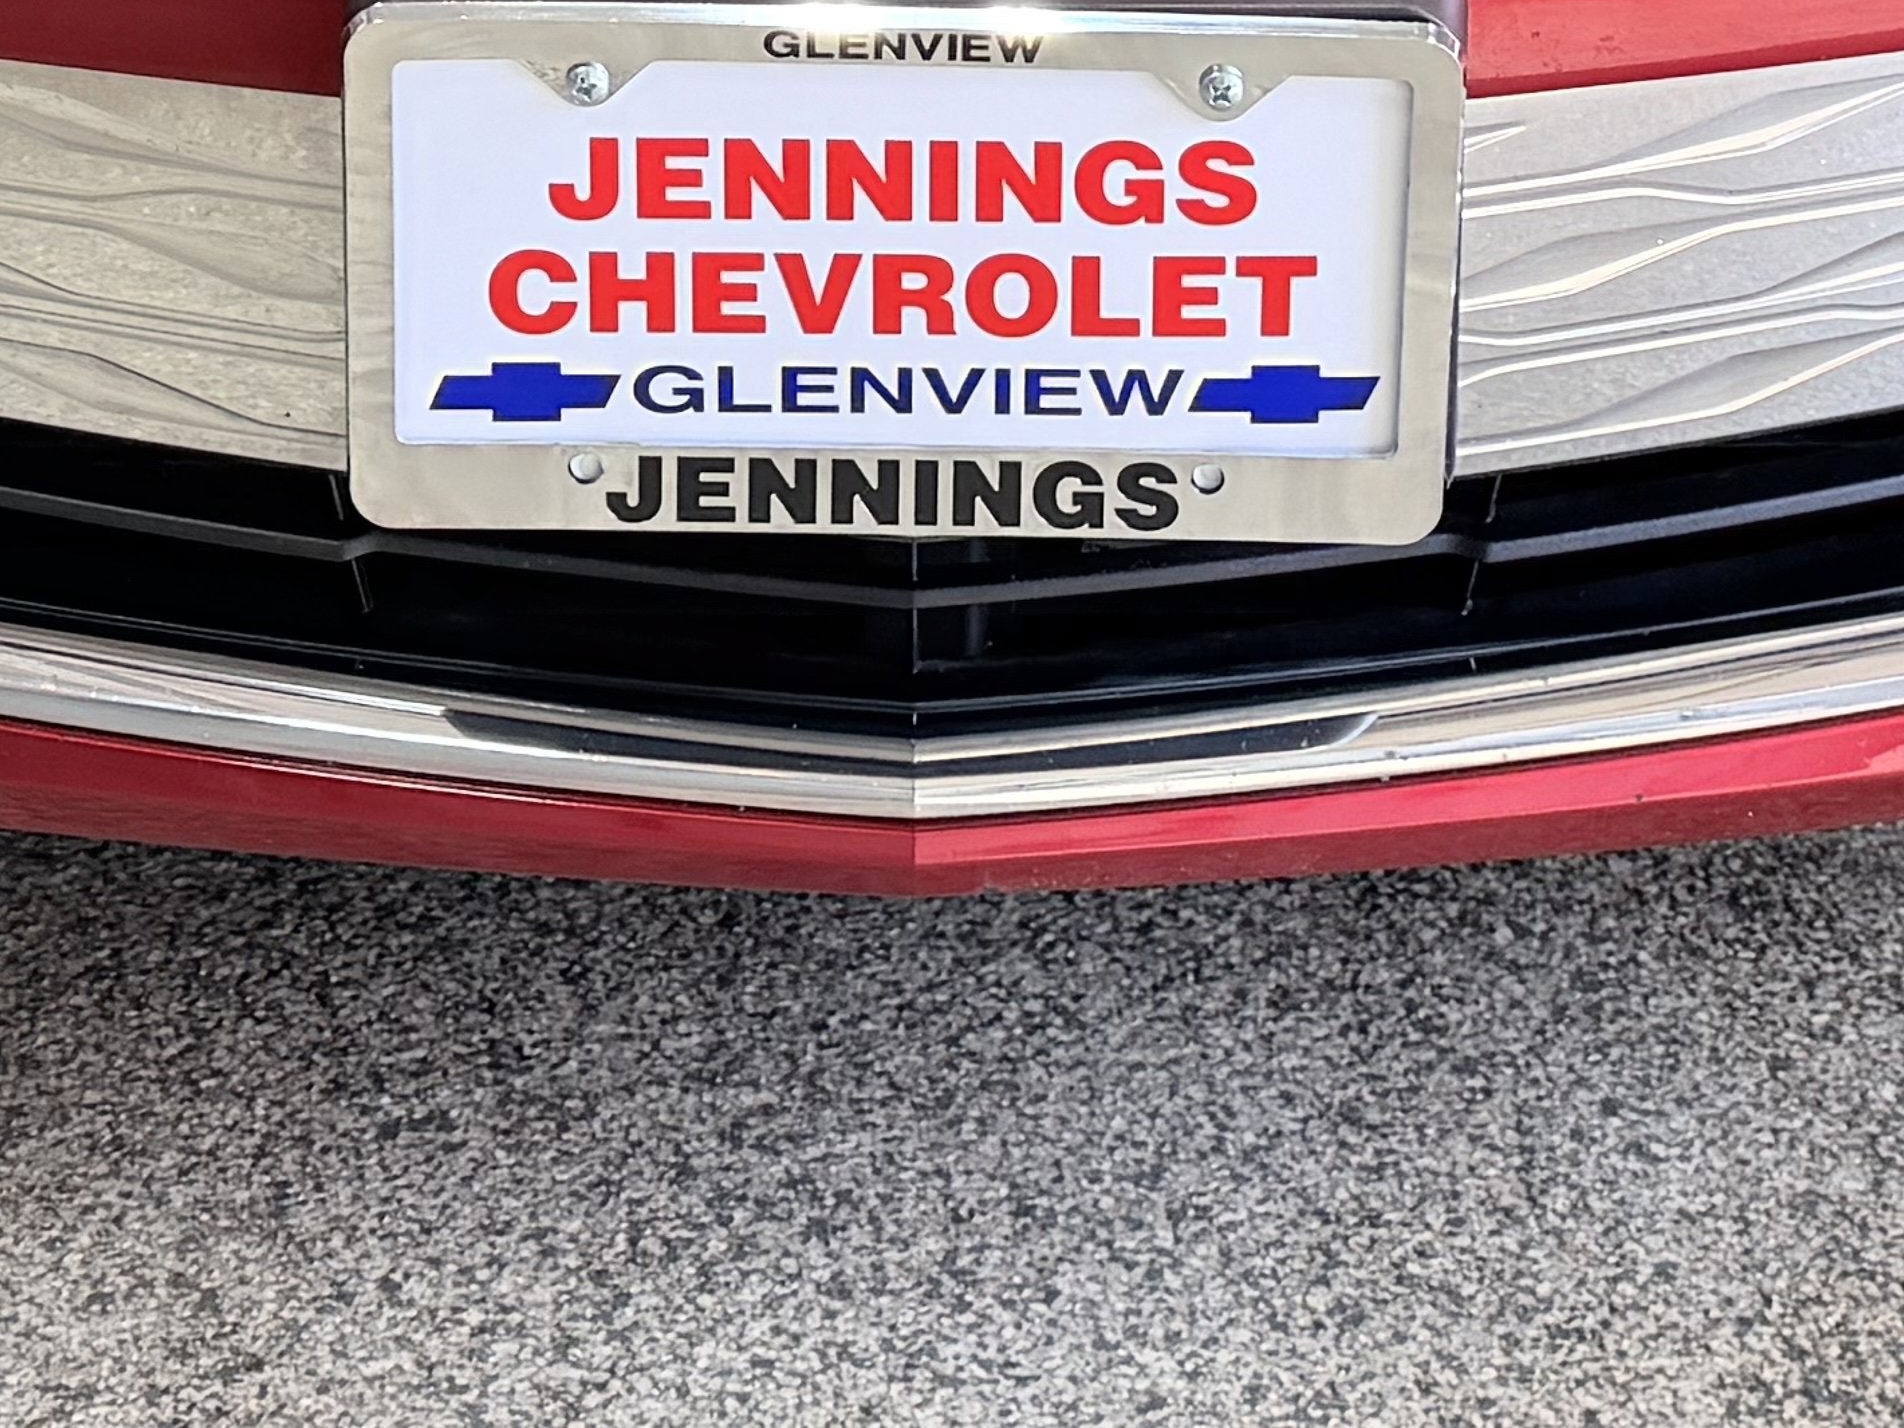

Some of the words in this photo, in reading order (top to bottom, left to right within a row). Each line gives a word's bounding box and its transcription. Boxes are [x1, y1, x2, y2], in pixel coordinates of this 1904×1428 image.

[762, 29, 1044, 65] GLENVIEW
[548, 137, 1259, 227] JENNINGS
[488, 249, 1319, 339] CHEVROLET
[632, 363, 1188, 418] GLENVIEW
[604, 454, 1181, 532] JENNINGS
